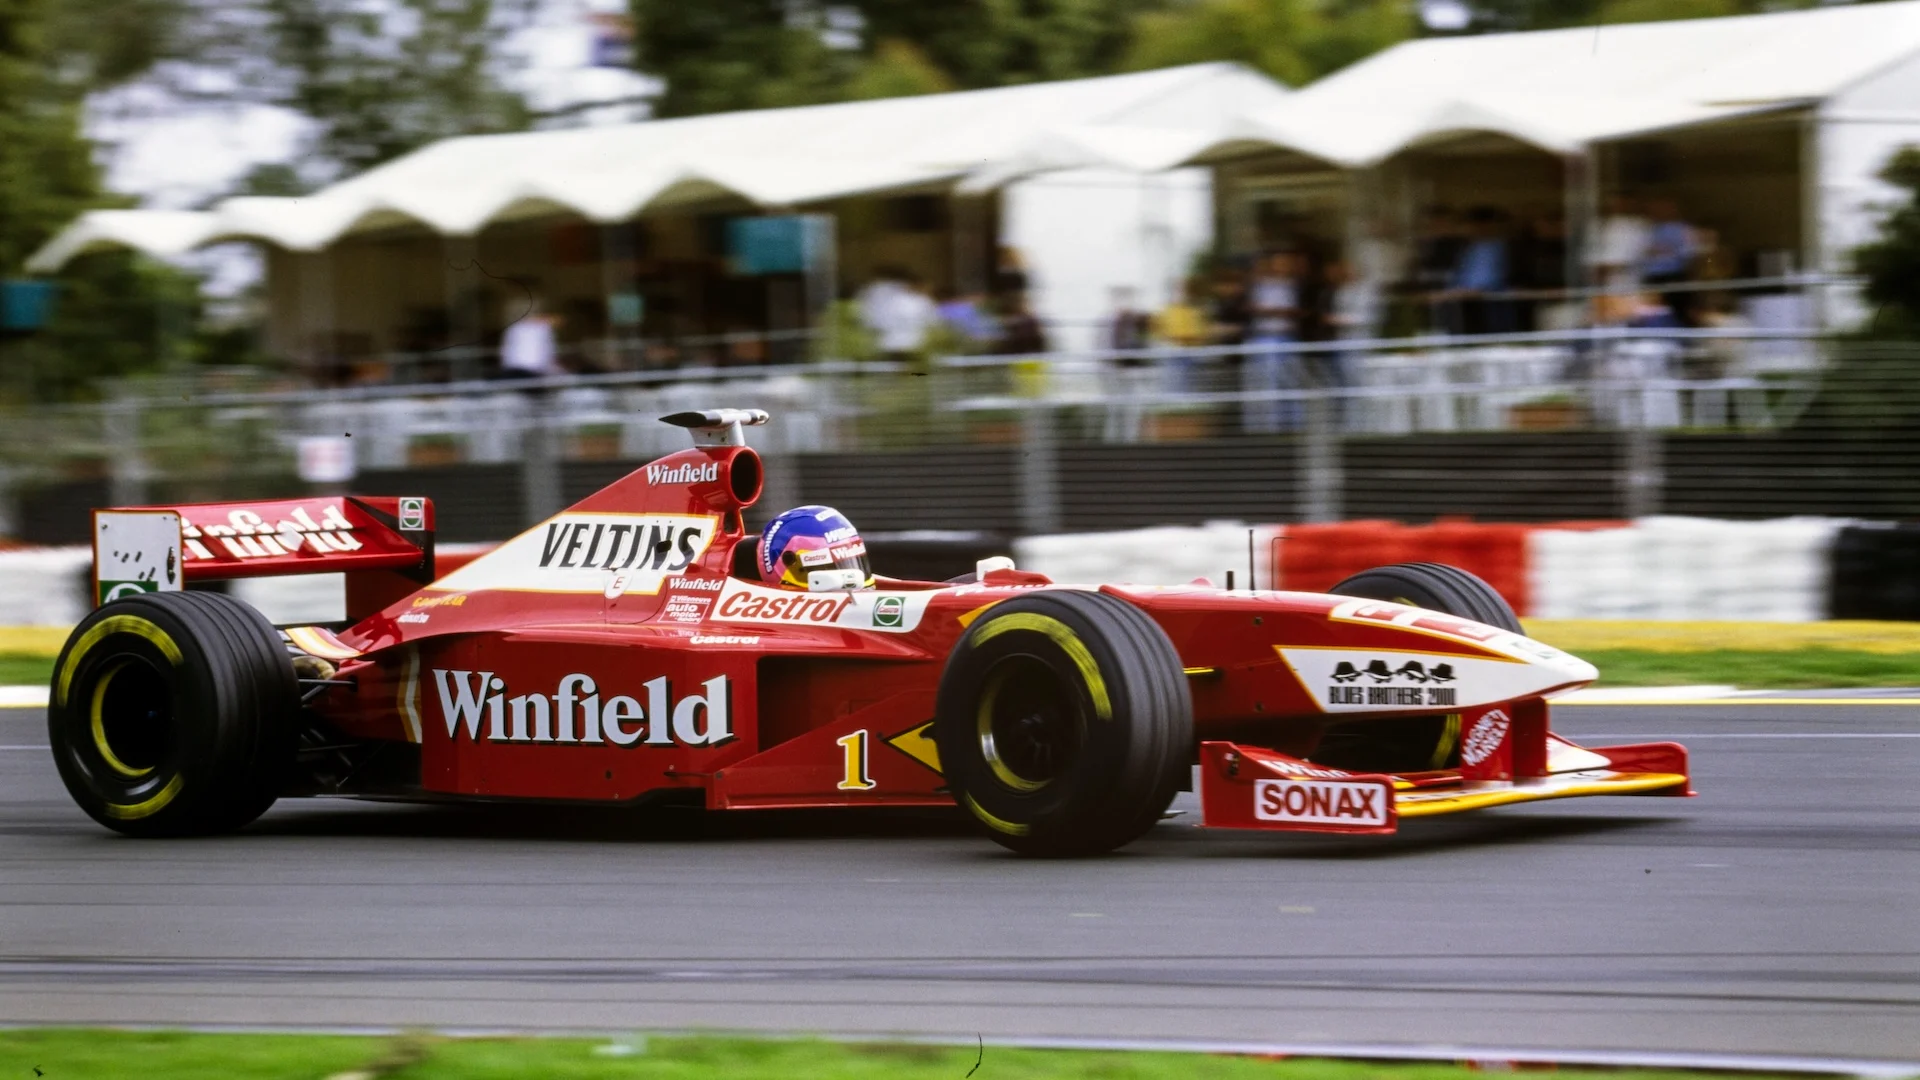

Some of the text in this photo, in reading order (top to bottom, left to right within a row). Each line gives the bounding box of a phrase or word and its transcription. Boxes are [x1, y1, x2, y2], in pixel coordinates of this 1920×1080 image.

[646, 462, 719, 485] Winfield
[182, 505, 364, 560] infield
[539, 523, 702, 571] VELTINS
[763, 521, 783, 574] Williams
[669, 577, 724, 591] Winfield
[666, 603, 698, 612] auto
[719, 591, 851, 623] Castrol
[689, 635, 760, 645] Castrol
[432, 669, 735, 746] Winfield
[1329, 686, 1363, 705] BLUES
[1367, 687, 1423, 706] BROTHERS
[837, 729, 877, 790] 1
[1262, 784, 1379, 820] SONAX
